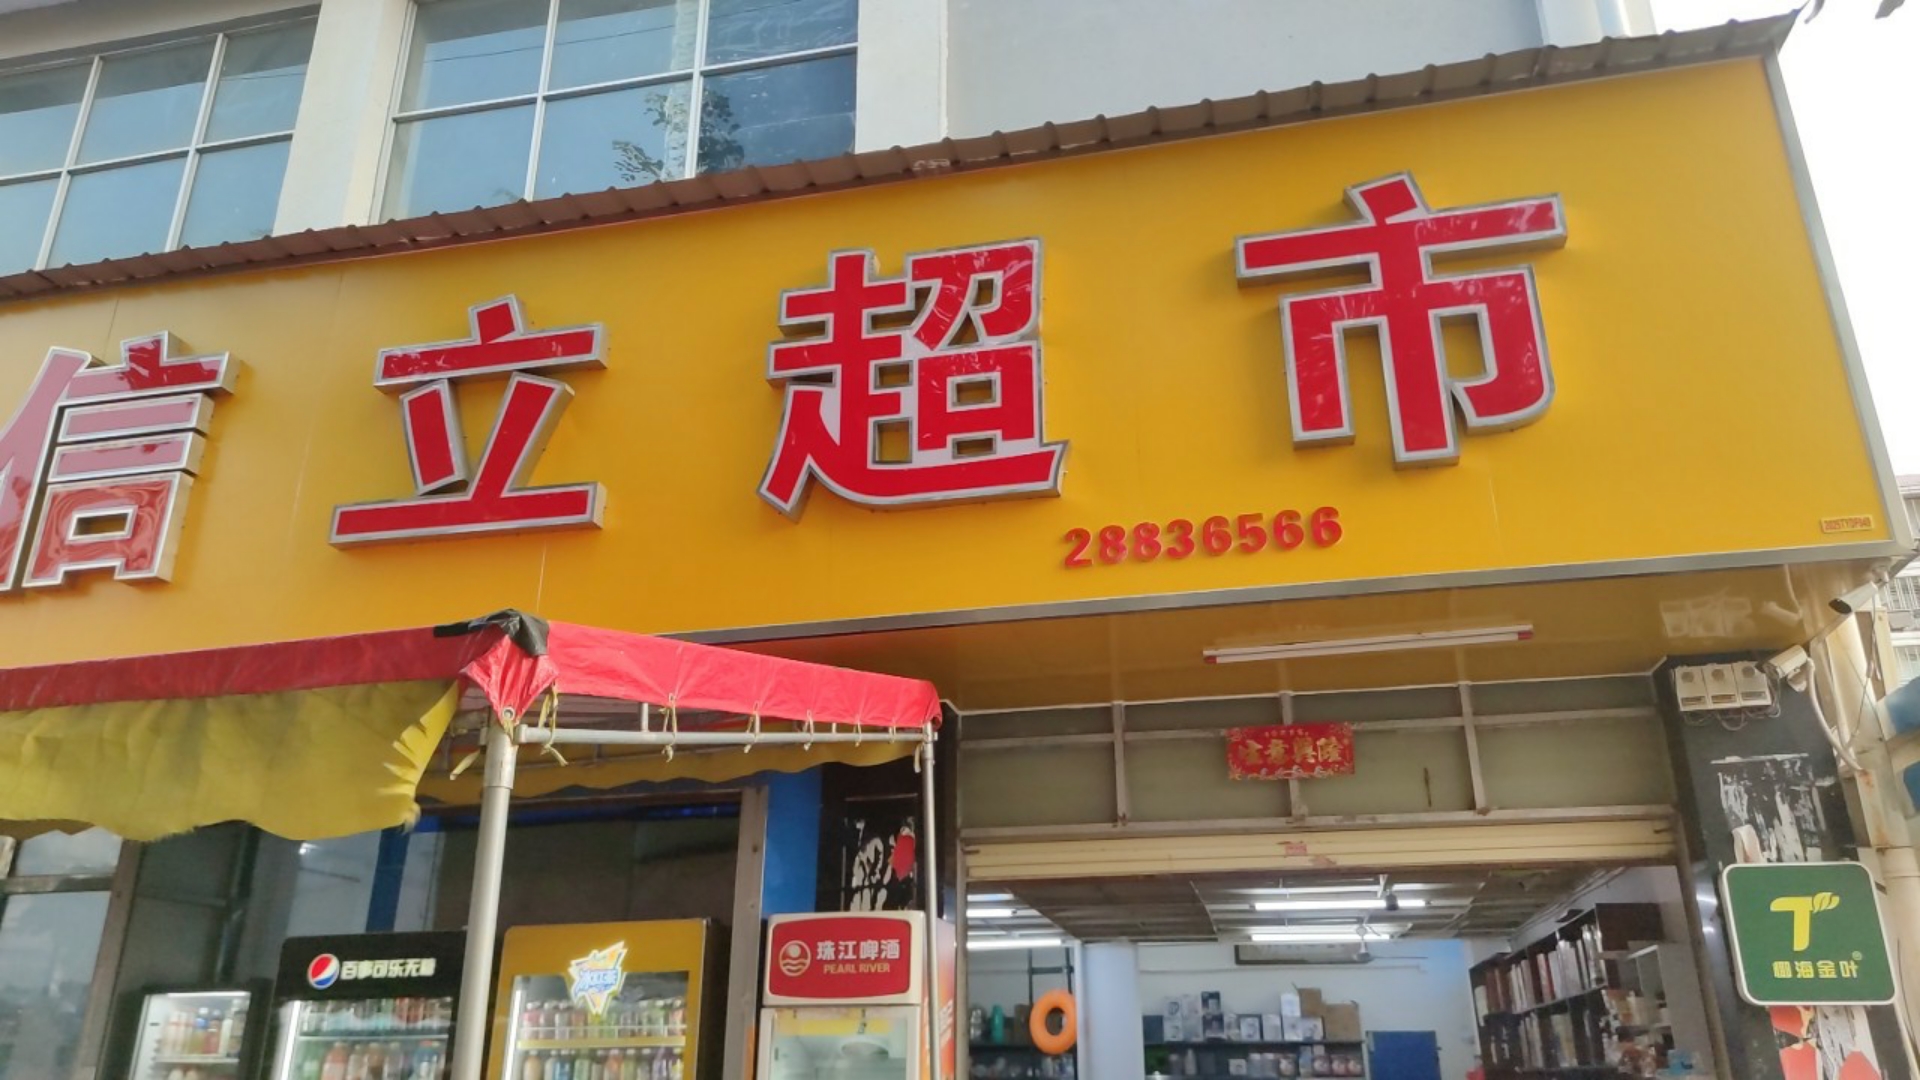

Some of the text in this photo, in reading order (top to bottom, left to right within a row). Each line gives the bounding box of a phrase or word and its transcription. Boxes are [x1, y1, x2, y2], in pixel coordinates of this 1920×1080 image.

[0, 172, 1567, 592] 信立超市
[1063, 507, 1343, 568] 28836566
[816, 939, 900, 961] 珠江啤酒
[340, 957, 437, 980] 百事可乐无糖
[823, 962, 890, 974] PEARL RIVER
